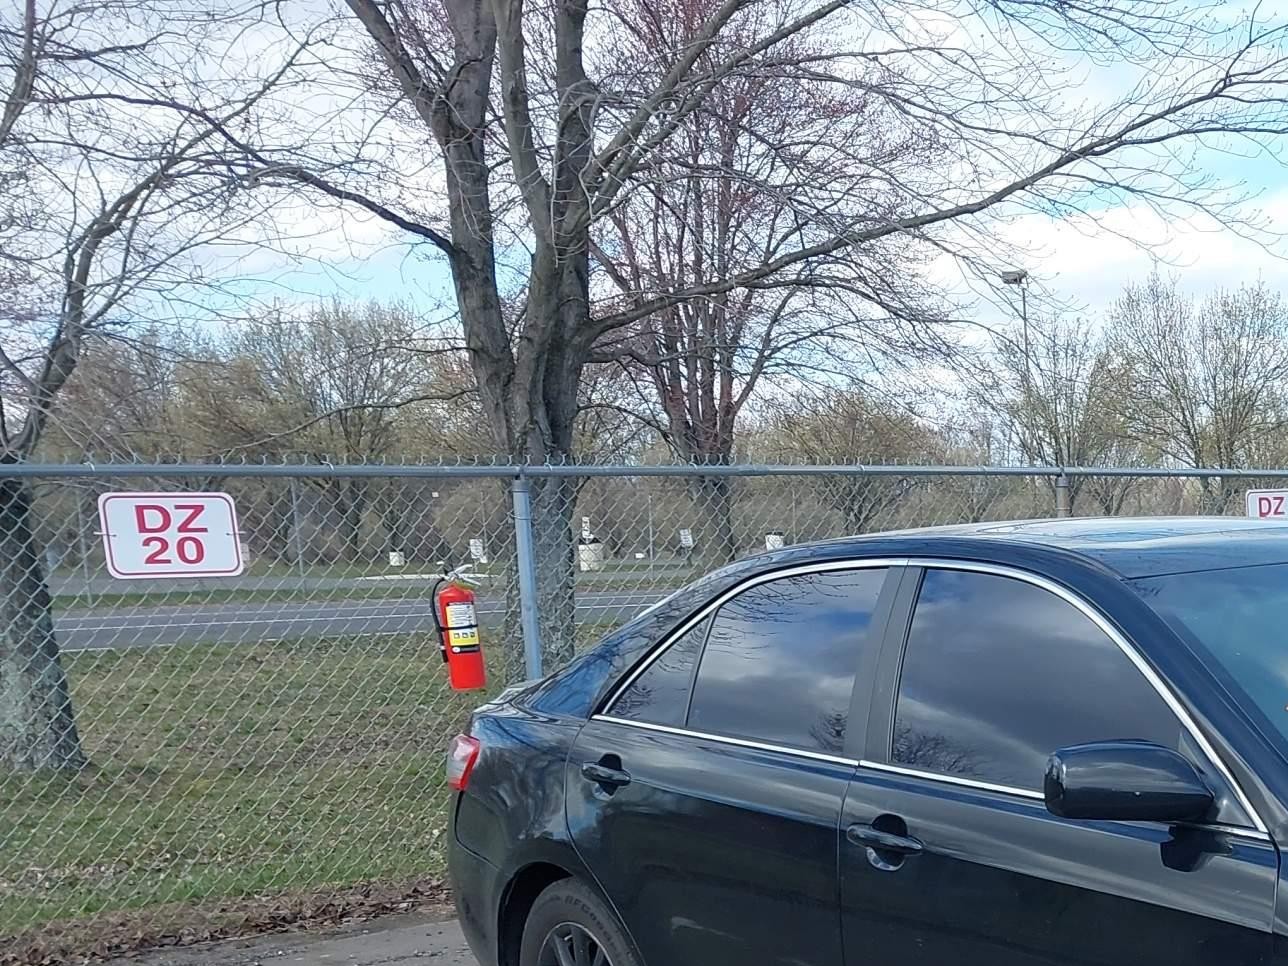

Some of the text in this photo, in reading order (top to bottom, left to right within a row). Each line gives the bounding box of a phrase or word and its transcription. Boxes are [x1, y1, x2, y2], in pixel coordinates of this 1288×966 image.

[134, 504, 209, 534] DZ
[1257, 496, 1286, 518] DZ
[141, 536, 205, 565] 20
